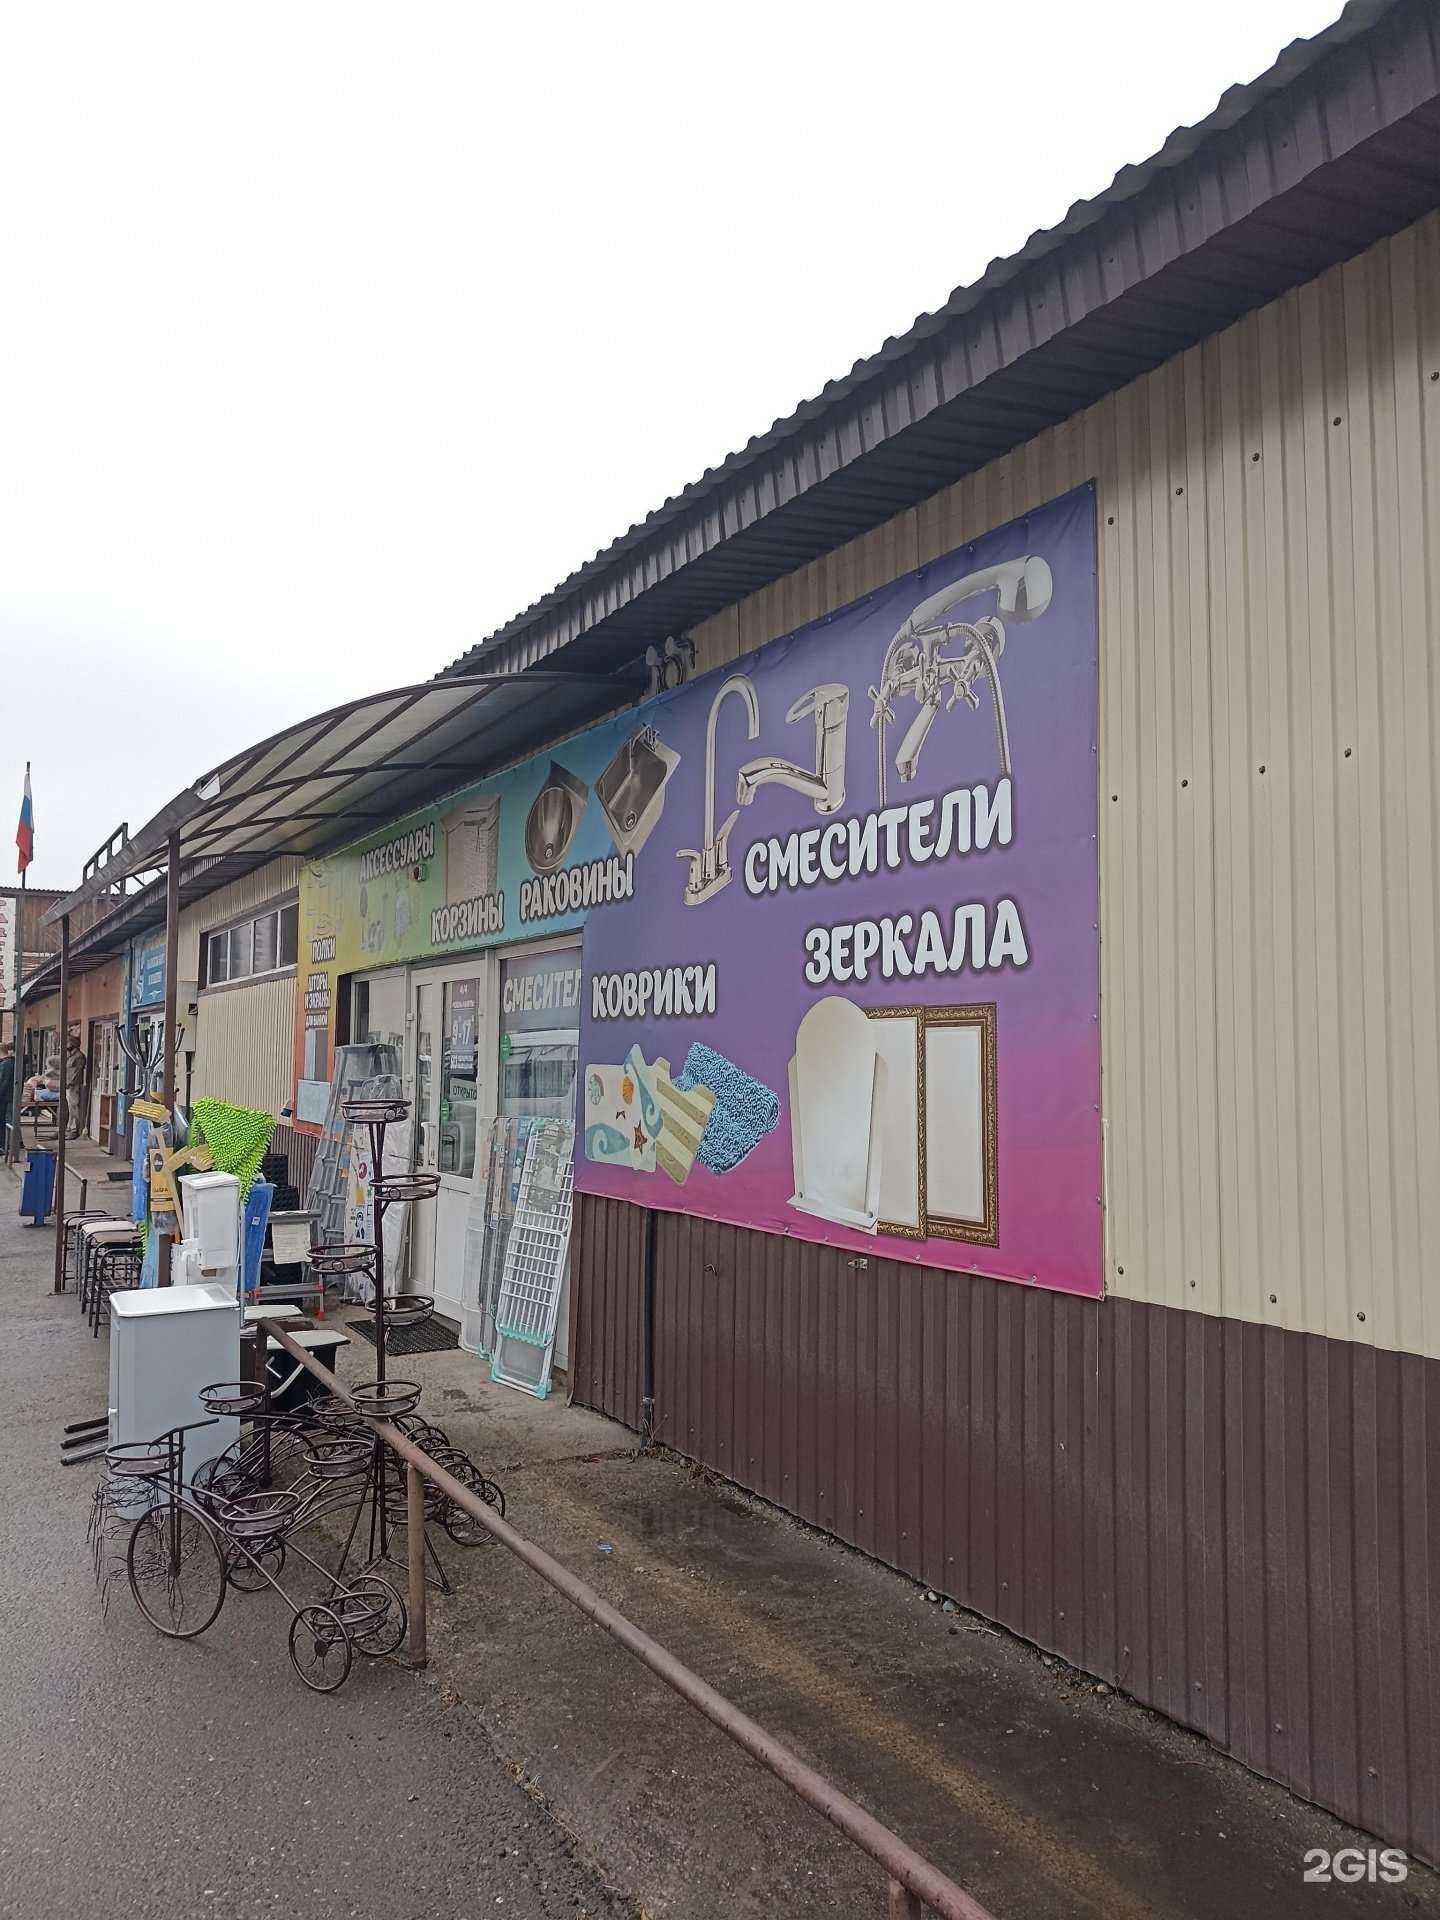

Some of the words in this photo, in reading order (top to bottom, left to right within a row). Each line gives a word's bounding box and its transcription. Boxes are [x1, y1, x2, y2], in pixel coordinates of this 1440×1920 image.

[359, 825, 435, 882] АКСЕССУАРЫ
[744, 778, 1013, 894] СМЕСИТЕЛИ
[520, 853, 634, 919] РАКОВИНЫ
[431, 891, 504, 943] КОРЗИНЫ
[804, 899, 1029, 984] ЗЕРКАЛА
[312, 936, 337, 964] ПОЛКИ
[591, 963, 716, 1019] КОВРИКИ
[452, 1084, 478, 1101] ОТКРЫТО
